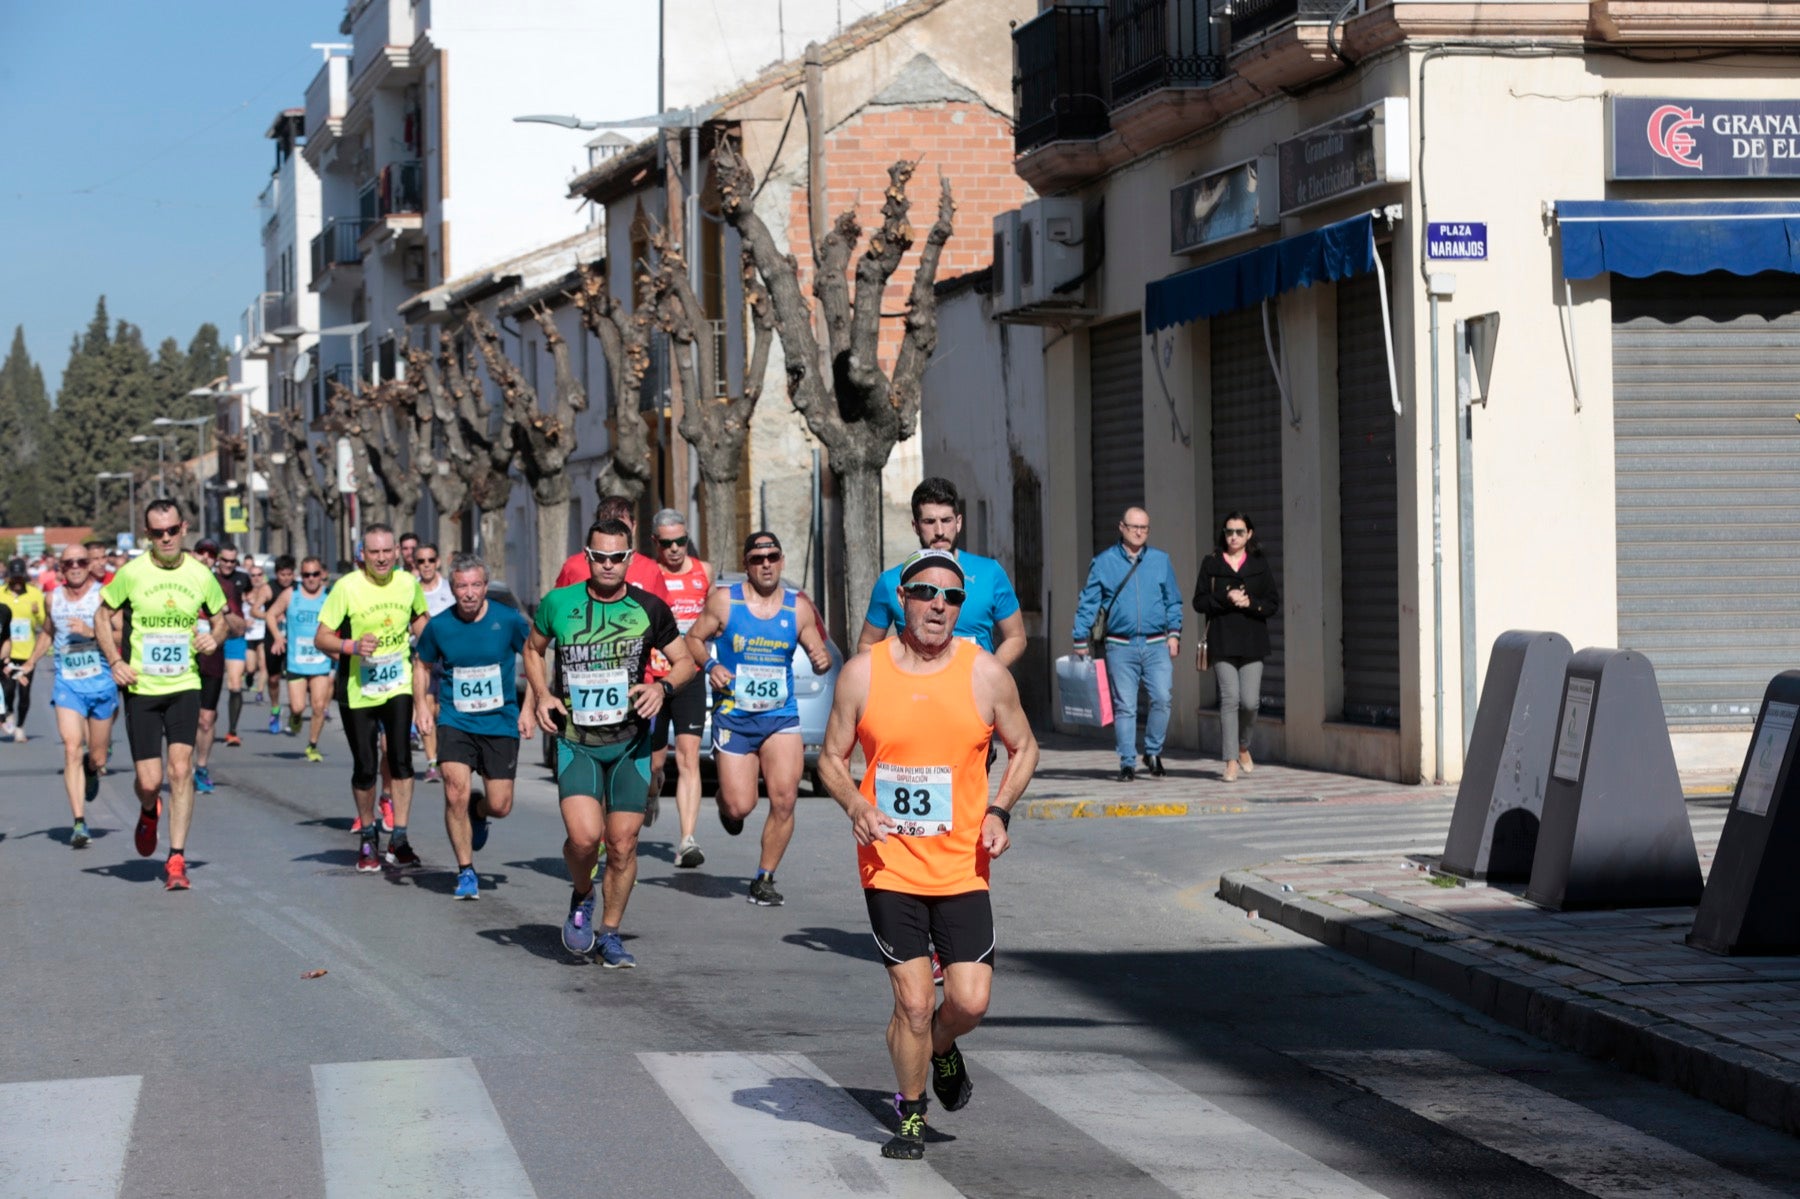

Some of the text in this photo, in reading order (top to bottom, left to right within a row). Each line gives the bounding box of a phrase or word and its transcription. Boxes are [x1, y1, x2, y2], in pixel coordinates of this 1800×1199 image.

[1712, 115, 1800, 135] GRANA
[1304, 131, 1344, 164] Granadina
[1733, 138, 1767, 158] DE
[1297, 161, 1355, 204] de Electricidad
[1440, 225, 1472, 236] PLAZA
[1431, 241, 1484, 257] NARANJOS
[749, 637, 788, 650] olimpo
[151, 647, 182, 662] 625
[368, 665, 398, 682] 246
[461, 680, 492, 697] 641
[579, 687, 619, 707] 776
[744, 680, 778, 697] 458
[893, 787, 931, 816] 83
